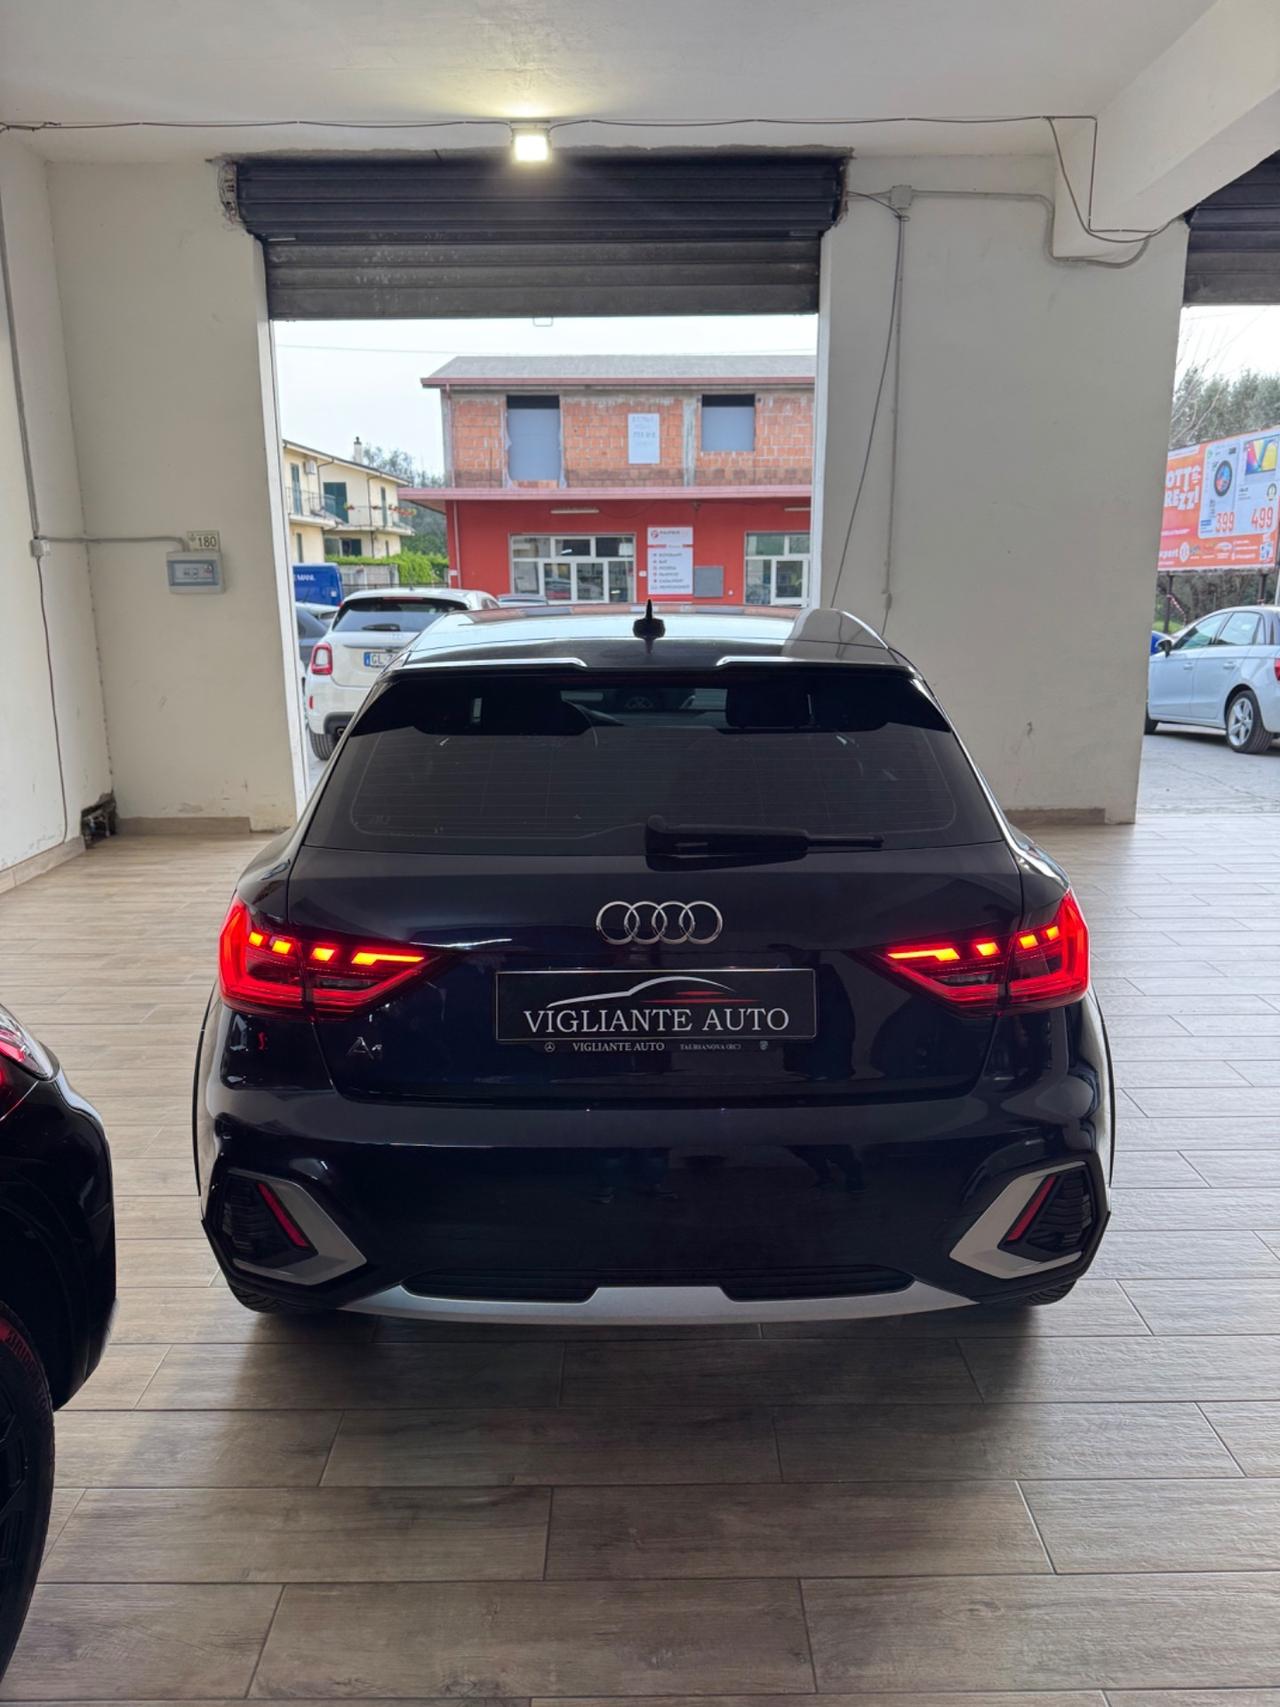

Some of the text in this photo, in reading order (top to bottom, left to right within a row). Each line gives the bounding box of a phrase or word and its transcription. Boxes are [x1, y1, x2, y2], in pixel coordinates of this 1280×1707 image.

[1215, 512, 1234, 532] 399
[1251, 507, 1273, 529] 499
[198, 535, 217, 548] 180
[524, 1007, 790, 1033] VIGLIANTE AUTO
[572, 1042, 632, 1052] VIGLIANTE
[633, 1042, 665, 1051] AUTO
